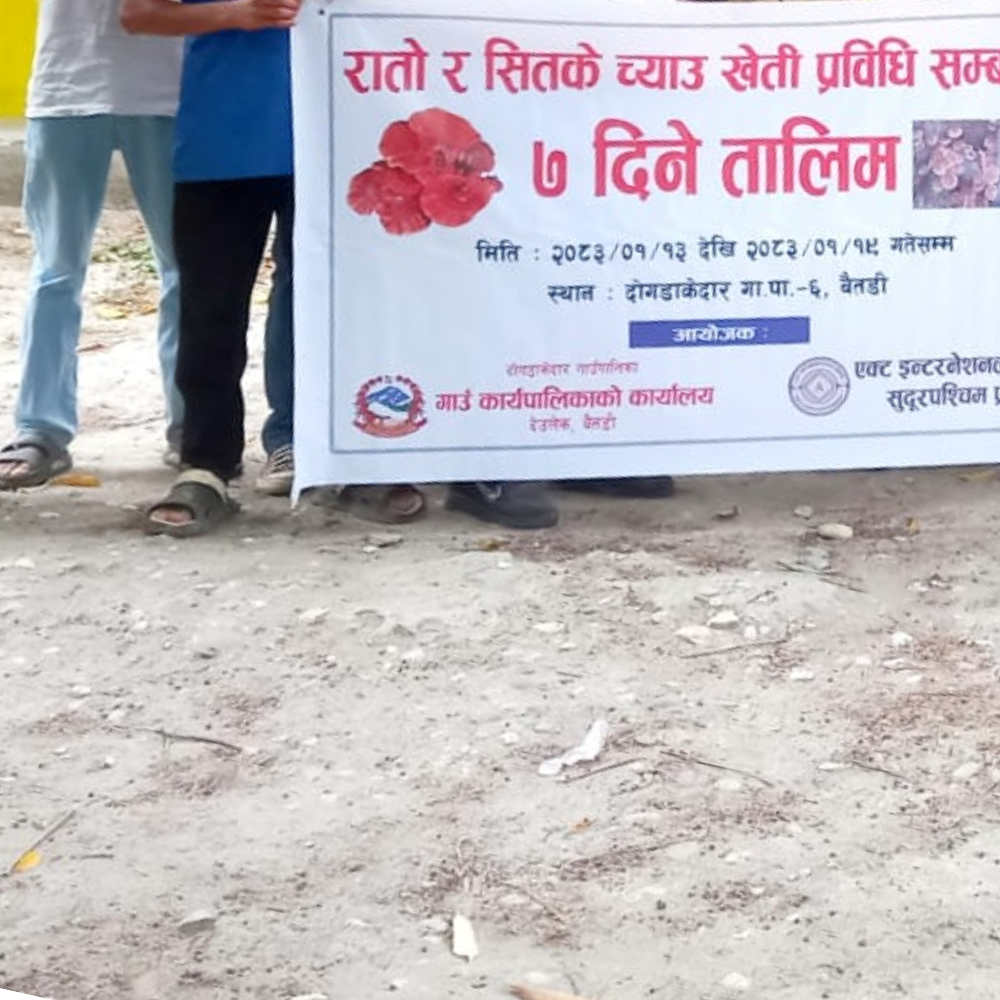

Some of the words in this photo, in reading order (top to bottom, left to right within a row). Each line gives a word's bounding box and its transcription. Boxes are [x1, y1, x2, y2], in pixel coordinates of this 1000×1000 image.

[343, 37, 429, 94] रातो
[442, 51, 471, 94] र
[483, 37, 603, 94] सितके
[616, 55, 708, 90] च्याउ
[721, 43, 803, 92] खेती
[816, 37, 918, 94] प्रविधि
[533, 141, 567, 197] ७
[592, 118, 702, 201] दिने
[720, 116, 901, 198] तालिम
[475, 239, 522, 262] मिति
[552, 242, 686, 266] २०८३/०१/१३
[698, 234, 737, 261] देखि
[746, 238, 879, 261] २०८३/०१/१९
[890, 233, 956, 254] गतेसम्म
[548, 285, 596, 303] स्थान
[671, 323, 757, 343] आयोजक
[854, 360, 892, 379] एक्ट
[479, 385, 622, 410] कार्यपालिकाको
[629, 384, 714, 406] कार्यालय
